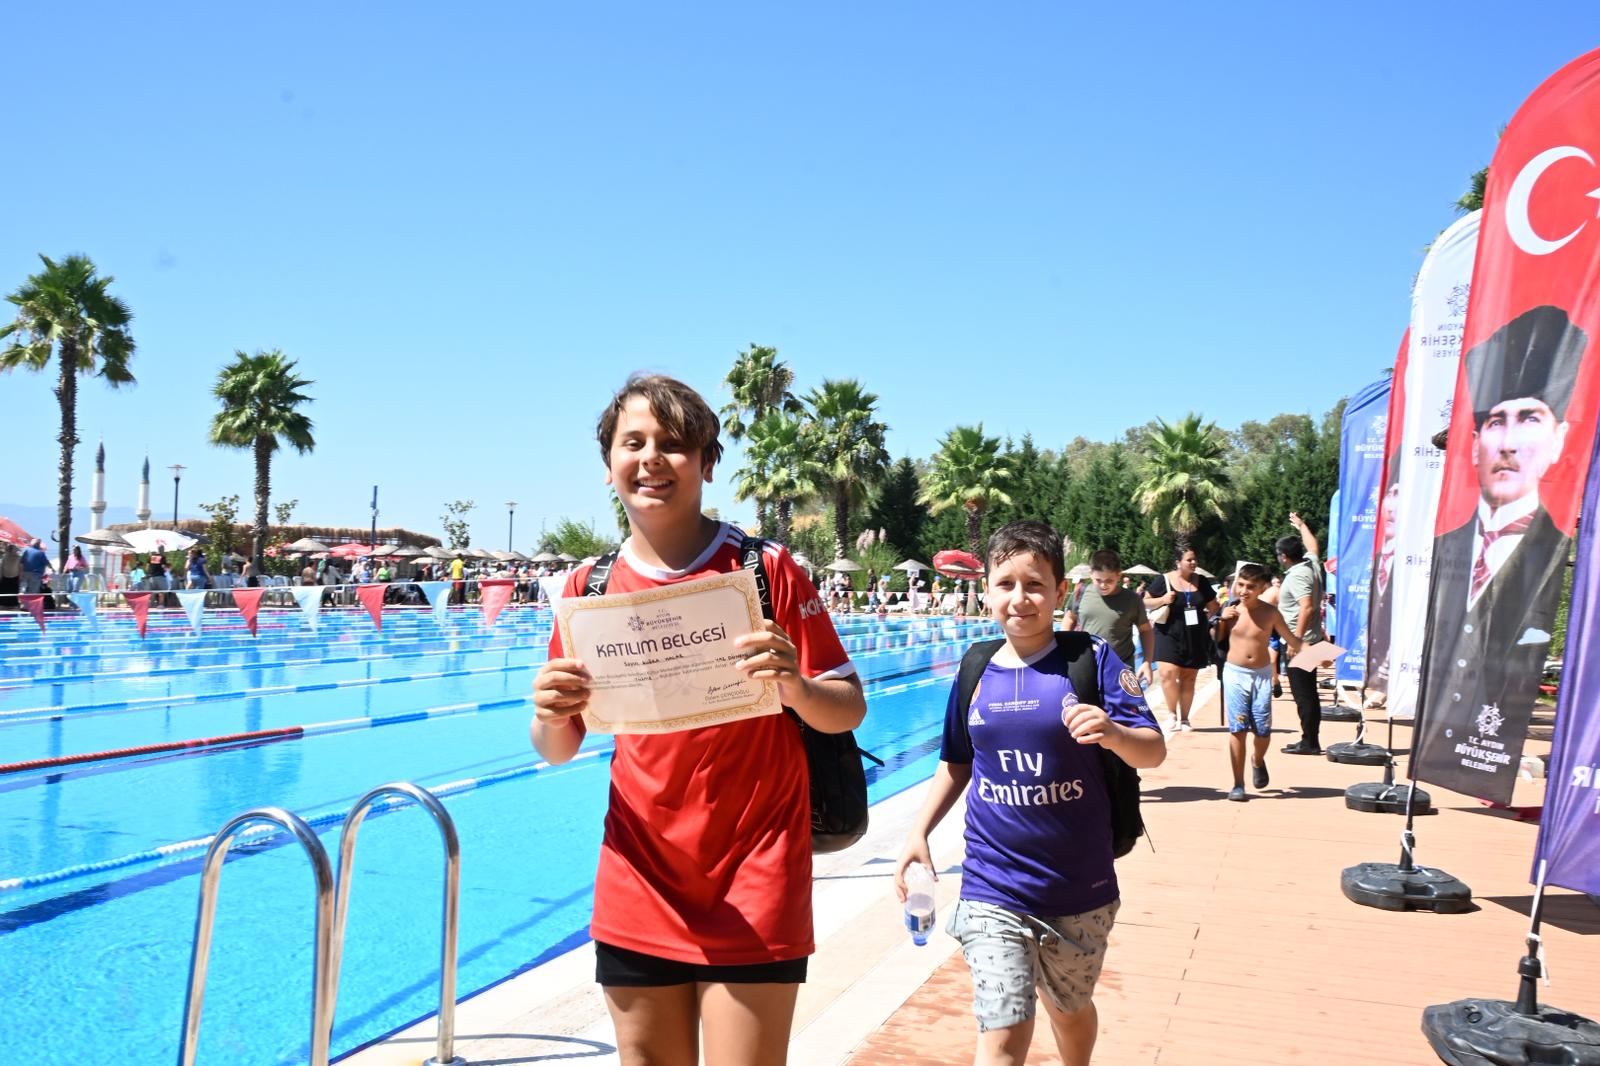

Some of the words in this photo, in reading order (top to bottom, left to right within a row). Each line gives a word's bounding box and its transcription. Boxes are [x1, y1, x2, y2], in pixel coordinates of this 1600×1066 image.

[596, 638, 658, 658] KATILIM
[662, 623, 727, 650] BELGESİ
[997, 750, 1043, 776] Fly
[978, 778, 1084, 807] Emirates
